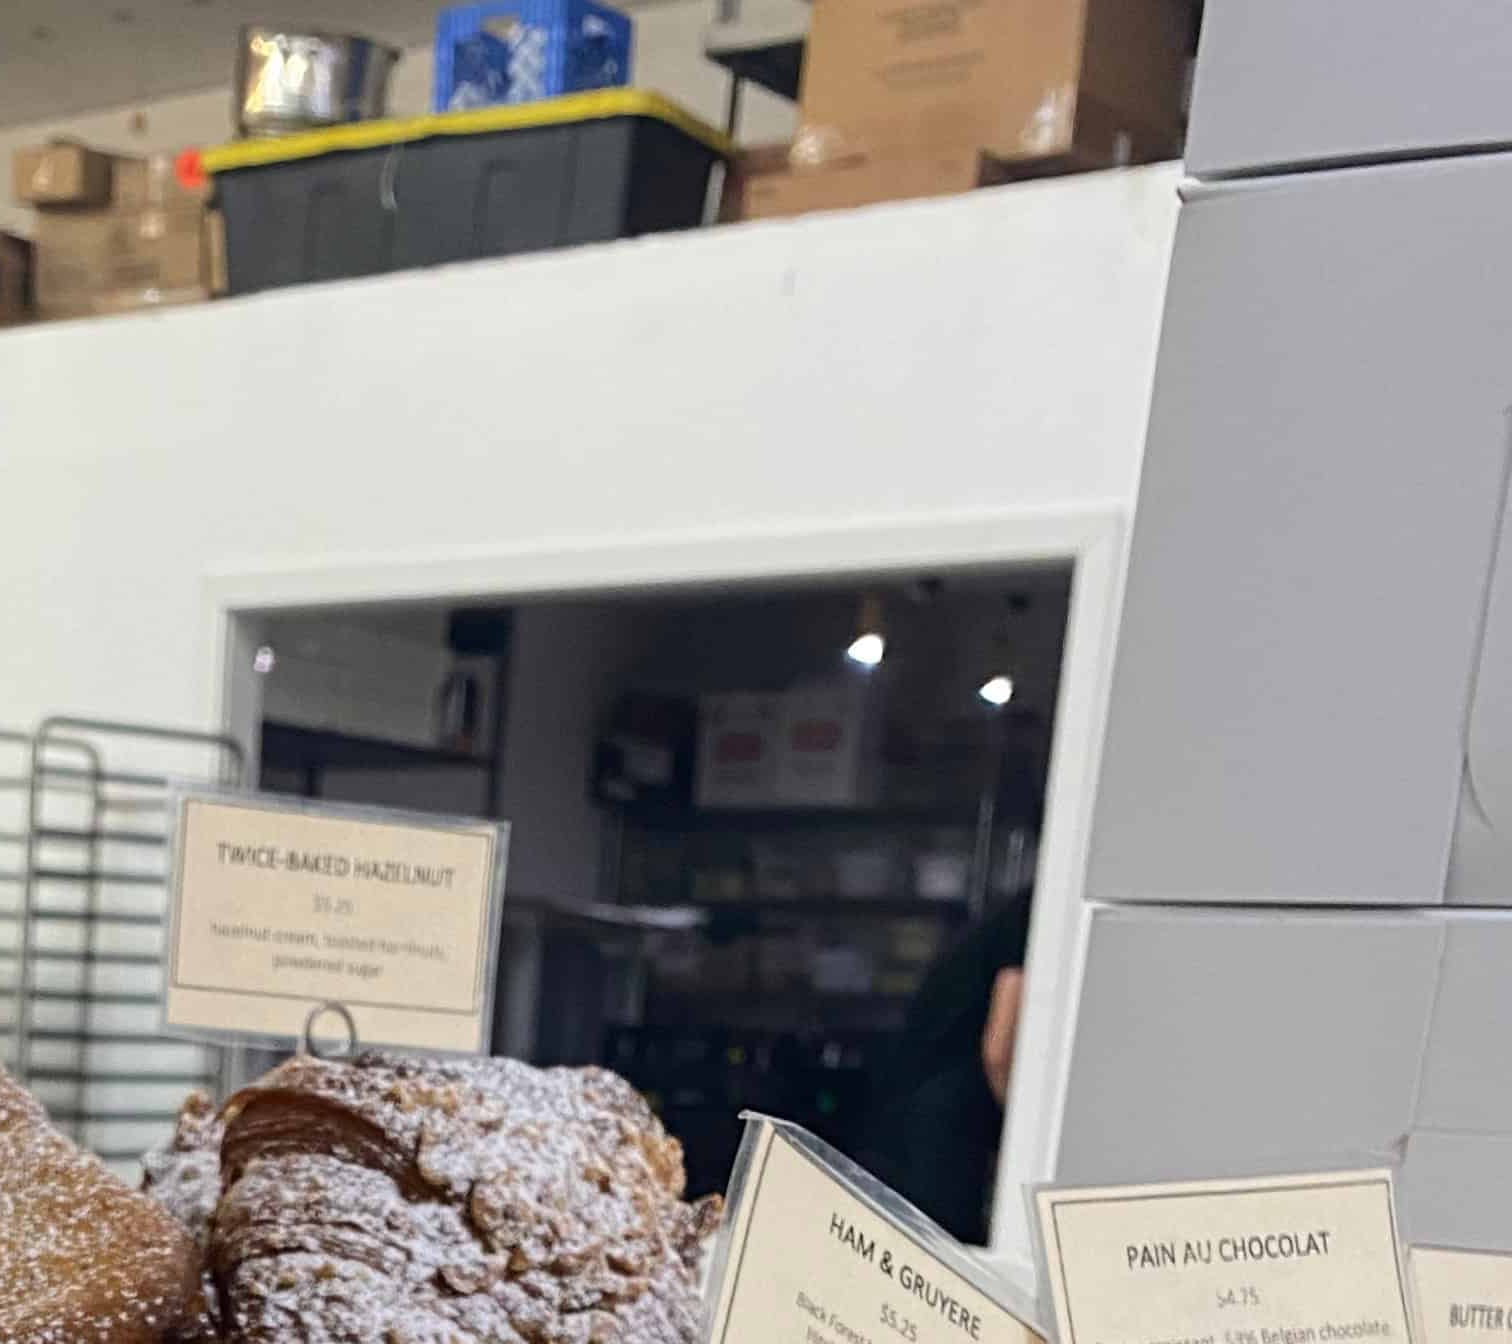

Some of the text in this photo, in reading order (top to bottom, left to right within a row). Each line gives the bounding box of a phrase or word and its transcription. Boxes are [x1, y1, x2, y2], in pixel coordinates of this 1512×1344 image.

[216, 842, 455, 889] TWICE-BAKED HAZELNUT
[1126, 1231, 1331, 1270] PAIN AU CHOCOLAT
[829, 1212, 983, 1341] HAM & GRUYERE
[1216, 1286, 1259, 1308] $4.75
[1449, 1303, 1504, 1329] BUTTER
[880, 1303, 918, 1343] $5.25
[1319, 1321, 1390, 1342] chocolate
